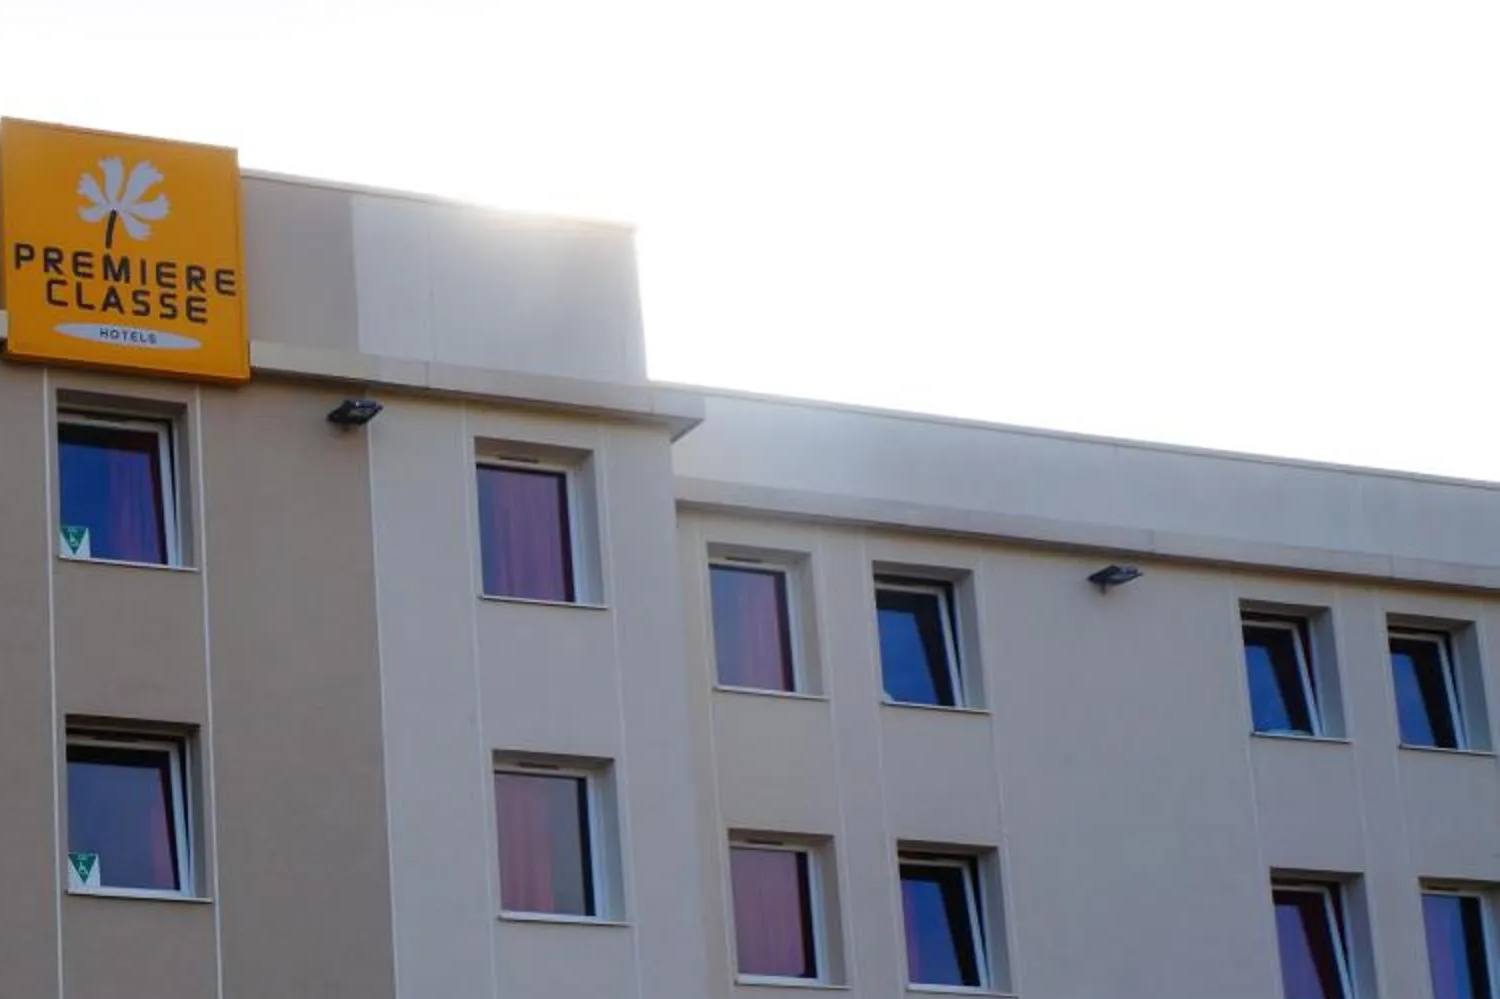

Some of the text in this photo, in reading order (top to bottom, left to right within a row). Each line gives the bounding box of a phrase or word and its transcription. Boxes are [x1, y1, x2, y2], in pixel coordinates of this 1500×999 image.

[14, 242, 237, 296] PREMIERE
[46, 279, 208, 324] CLASSE
[100, 327, 157, 344] HOTELS
